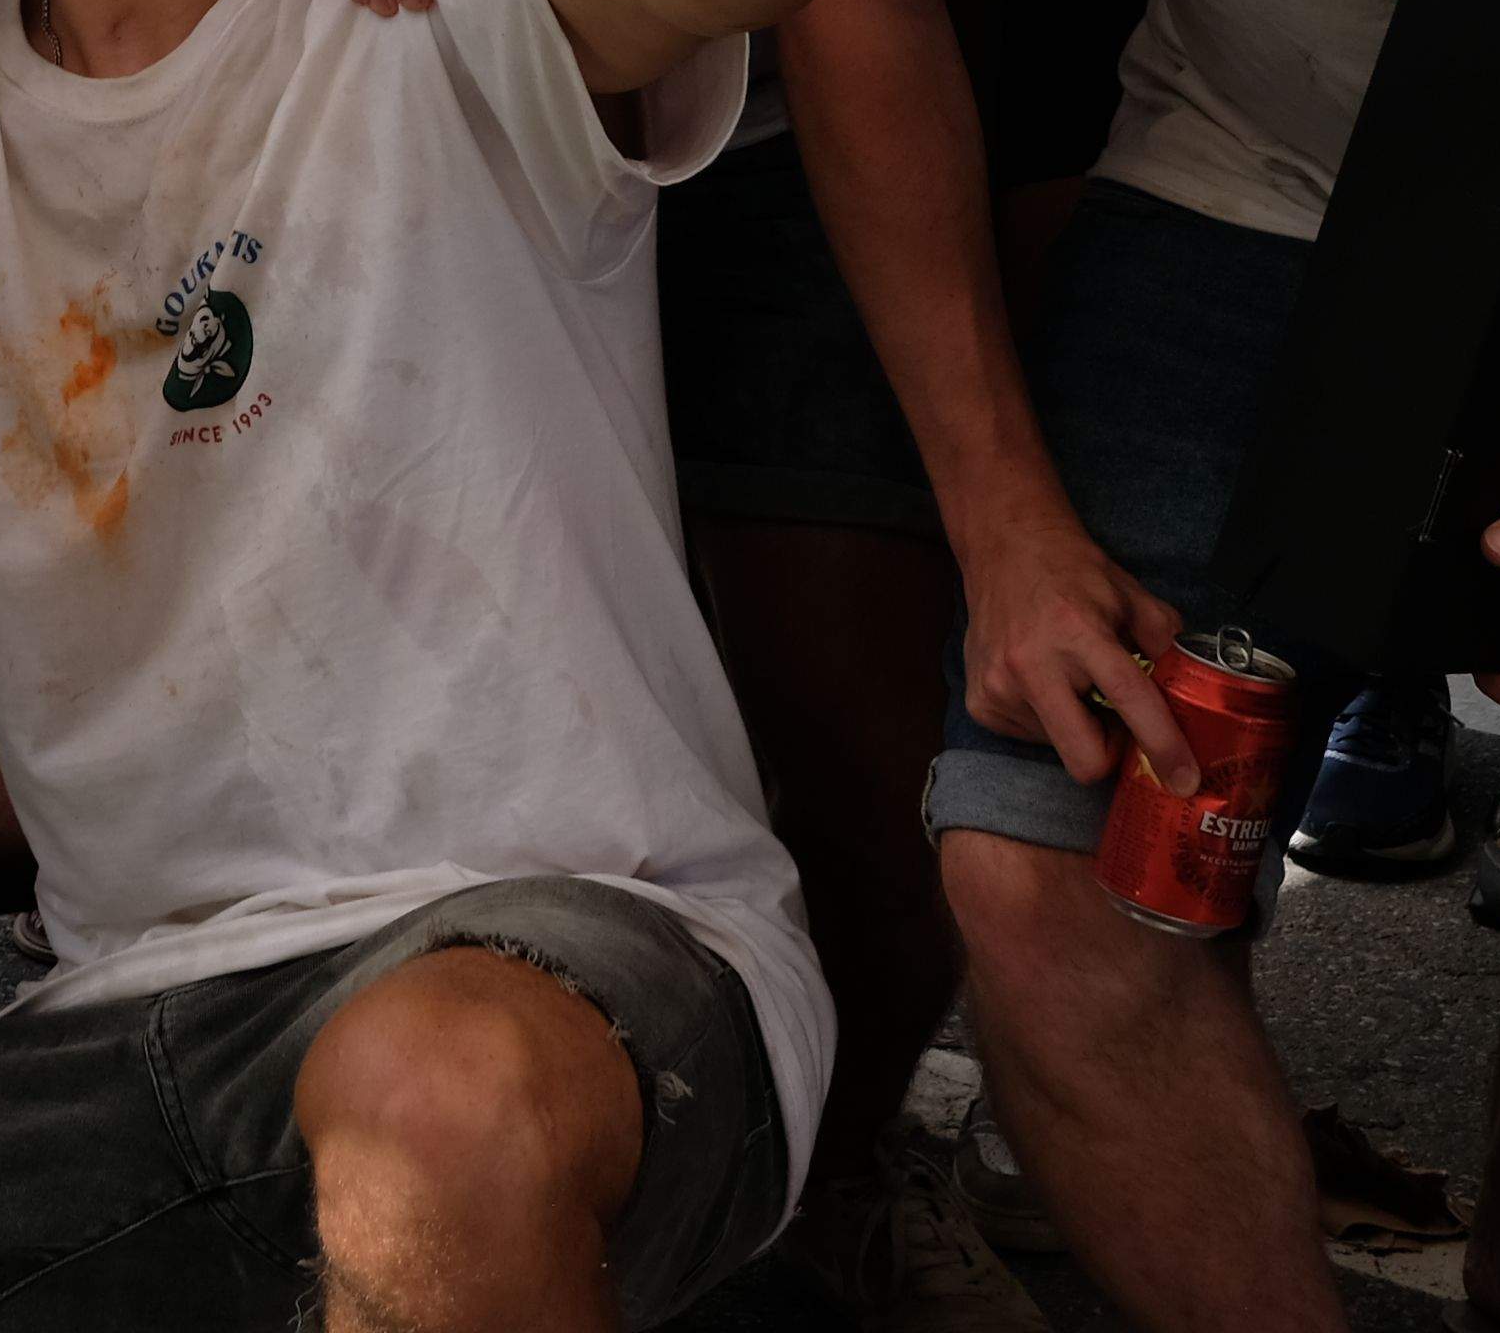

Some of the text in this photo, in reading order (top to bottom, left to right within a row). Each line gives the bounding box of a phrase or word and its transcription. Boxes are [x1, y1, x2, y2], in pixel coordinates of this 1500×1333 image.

[156, 230, 263, 337] GOURTS
[169, 392, 272, 447] SINCE 1993
